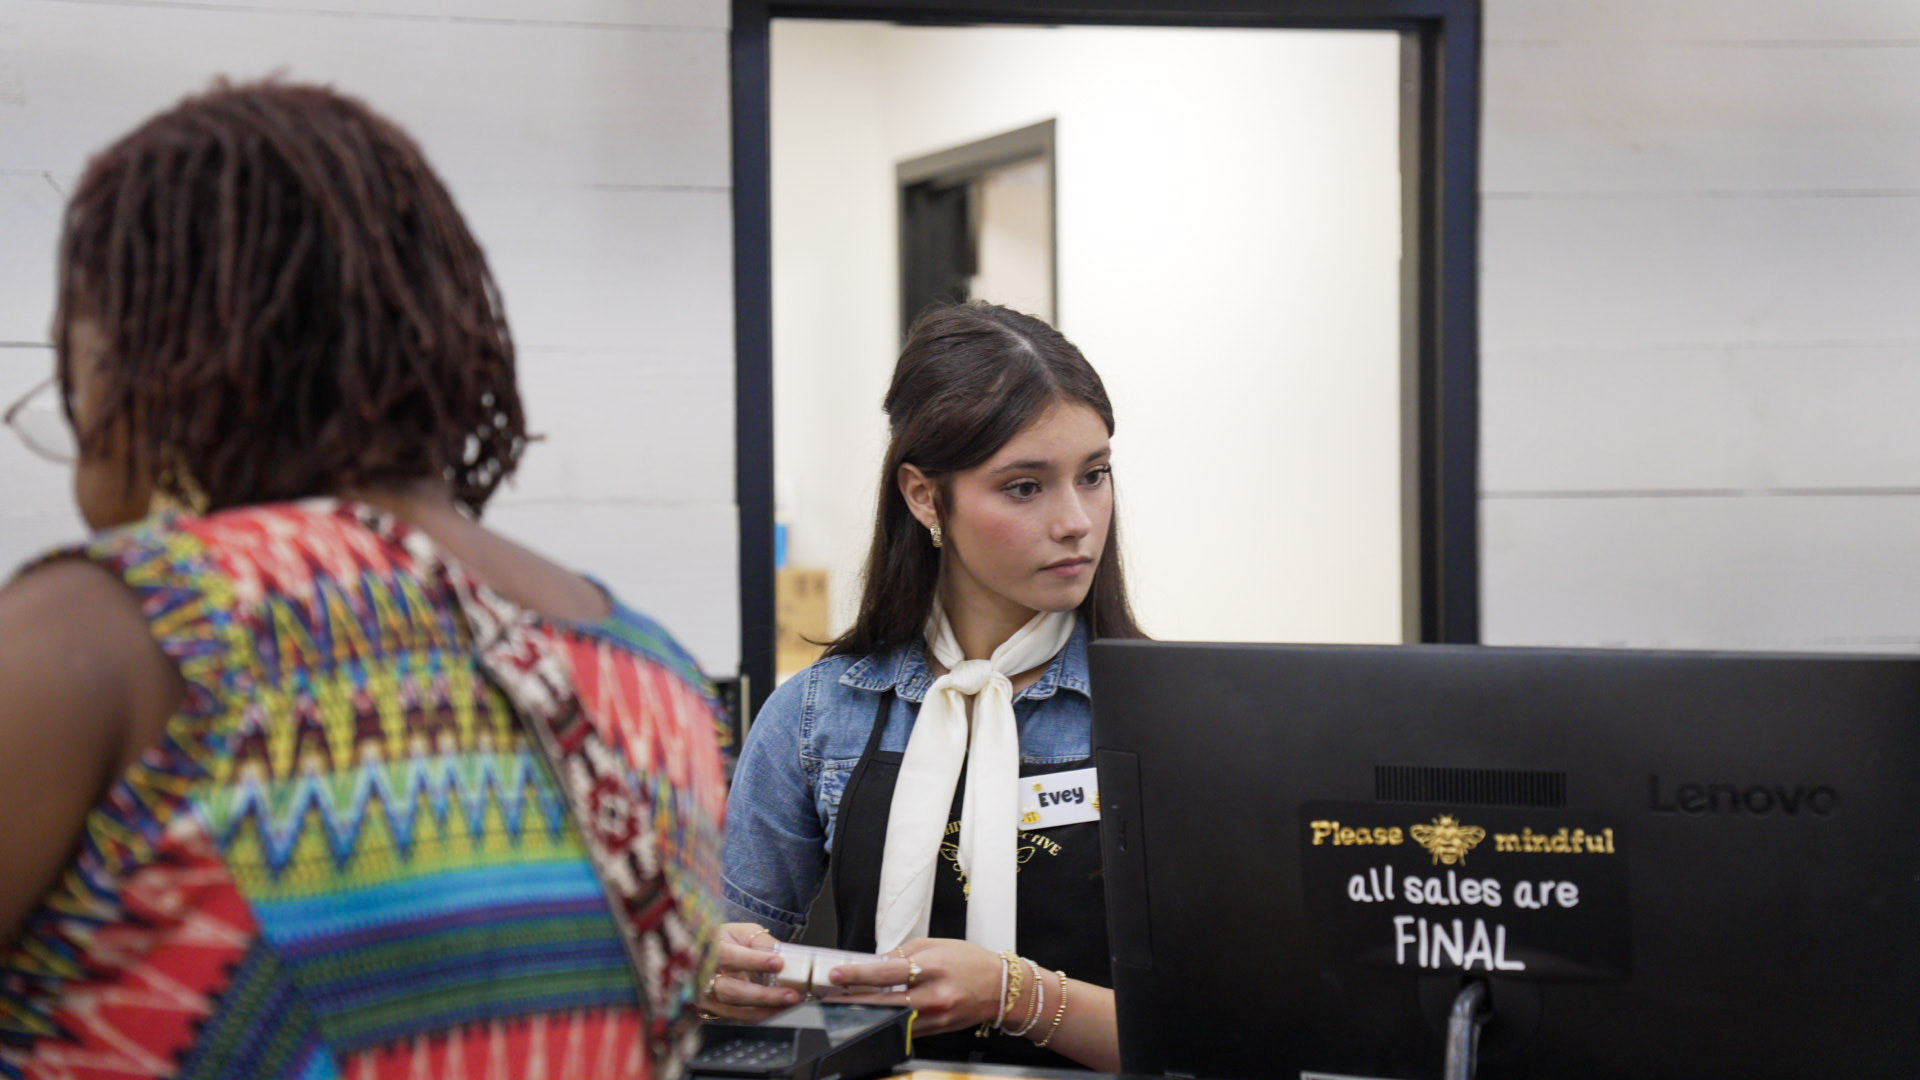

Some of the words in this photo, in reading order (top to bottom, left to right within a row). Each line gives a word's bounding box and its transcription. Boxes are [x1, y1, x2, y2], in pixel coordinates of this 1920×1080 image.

[1038, 786, 1085, 808] Evey
[1648, 774, 1837, 815] Lenovo
[1310, 820, 1404, 846] Please
[1493, 827, 1615, 854] mindful
[1347, 864, 1395, 902] all
[1403, 869, 1502, 907] sales
[1513, 880, 1580, 909] are
[1393, 915, 1526, 971] FINAL
